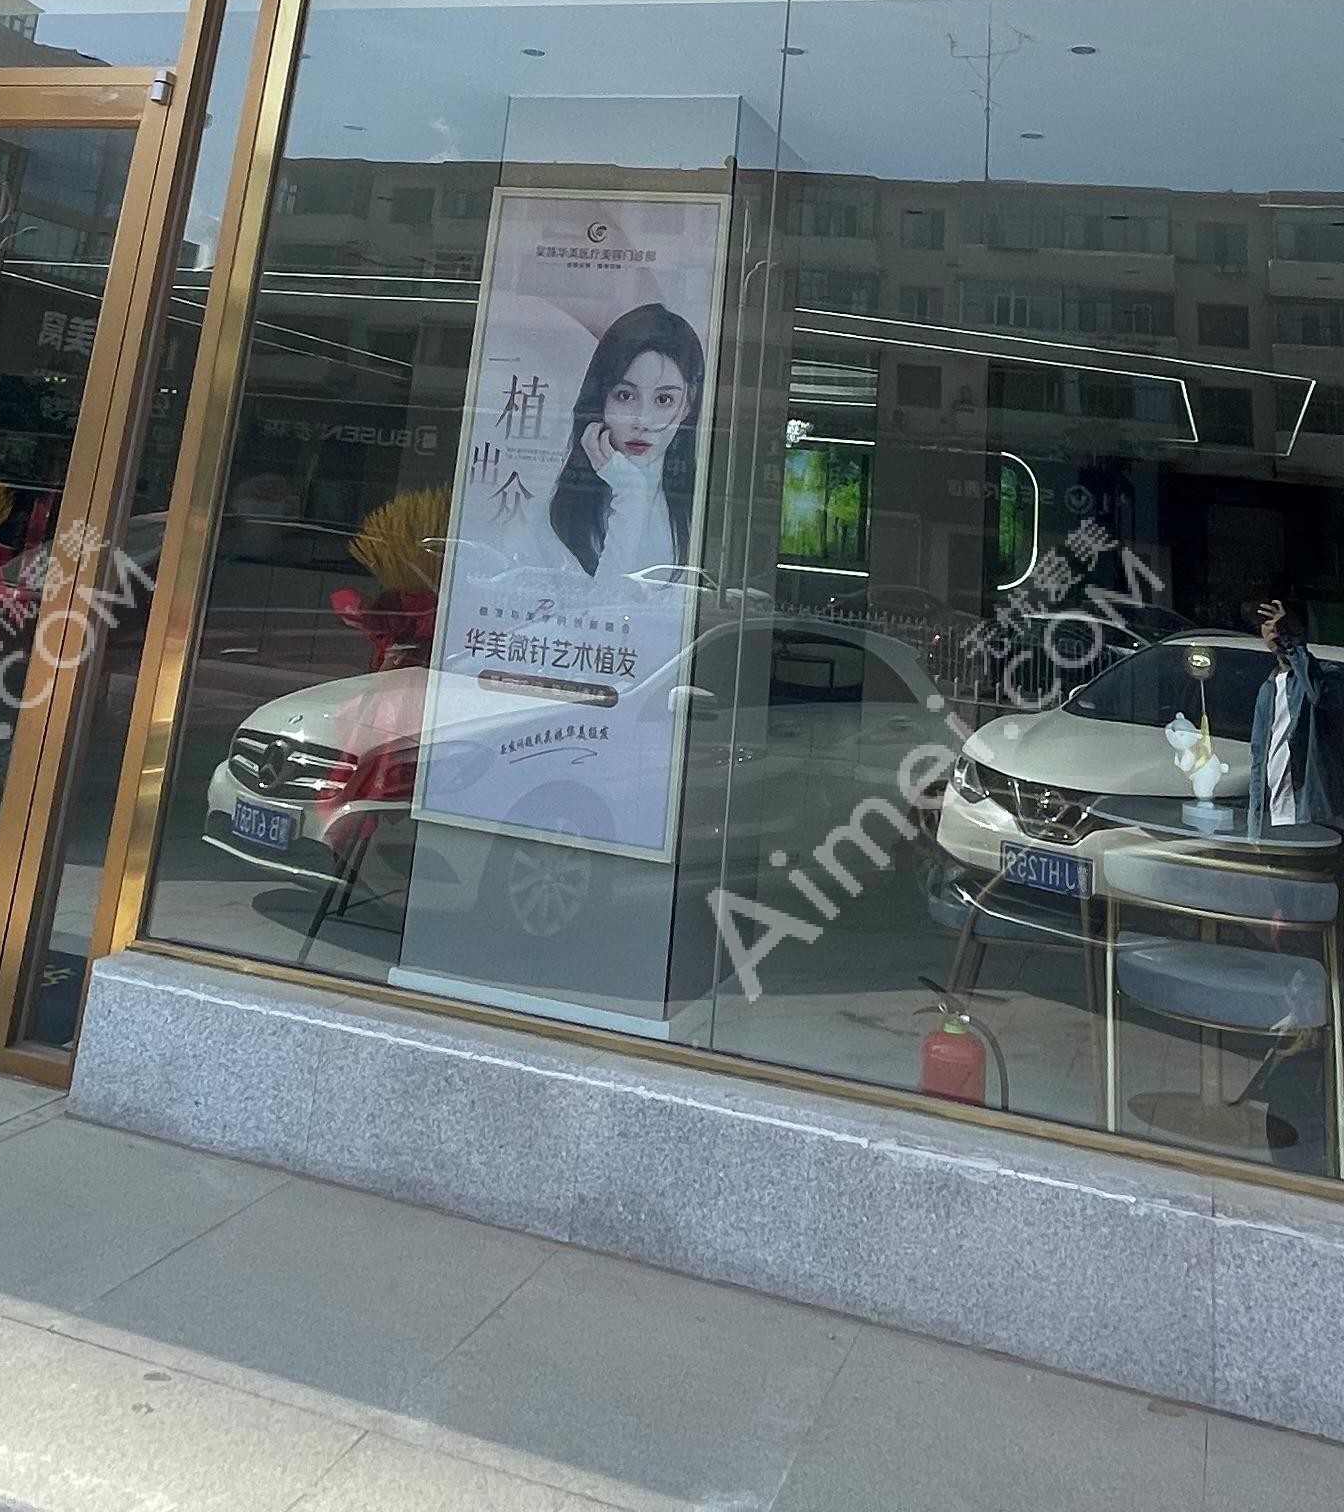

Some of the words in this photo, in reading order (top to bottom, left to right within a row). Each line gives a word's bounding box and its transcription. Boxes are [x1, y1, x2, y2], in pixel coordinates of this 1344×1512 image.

[469, 356, 550, 525] 一植出众
[464, 627, 638, 678] 华美微针艺术植发
